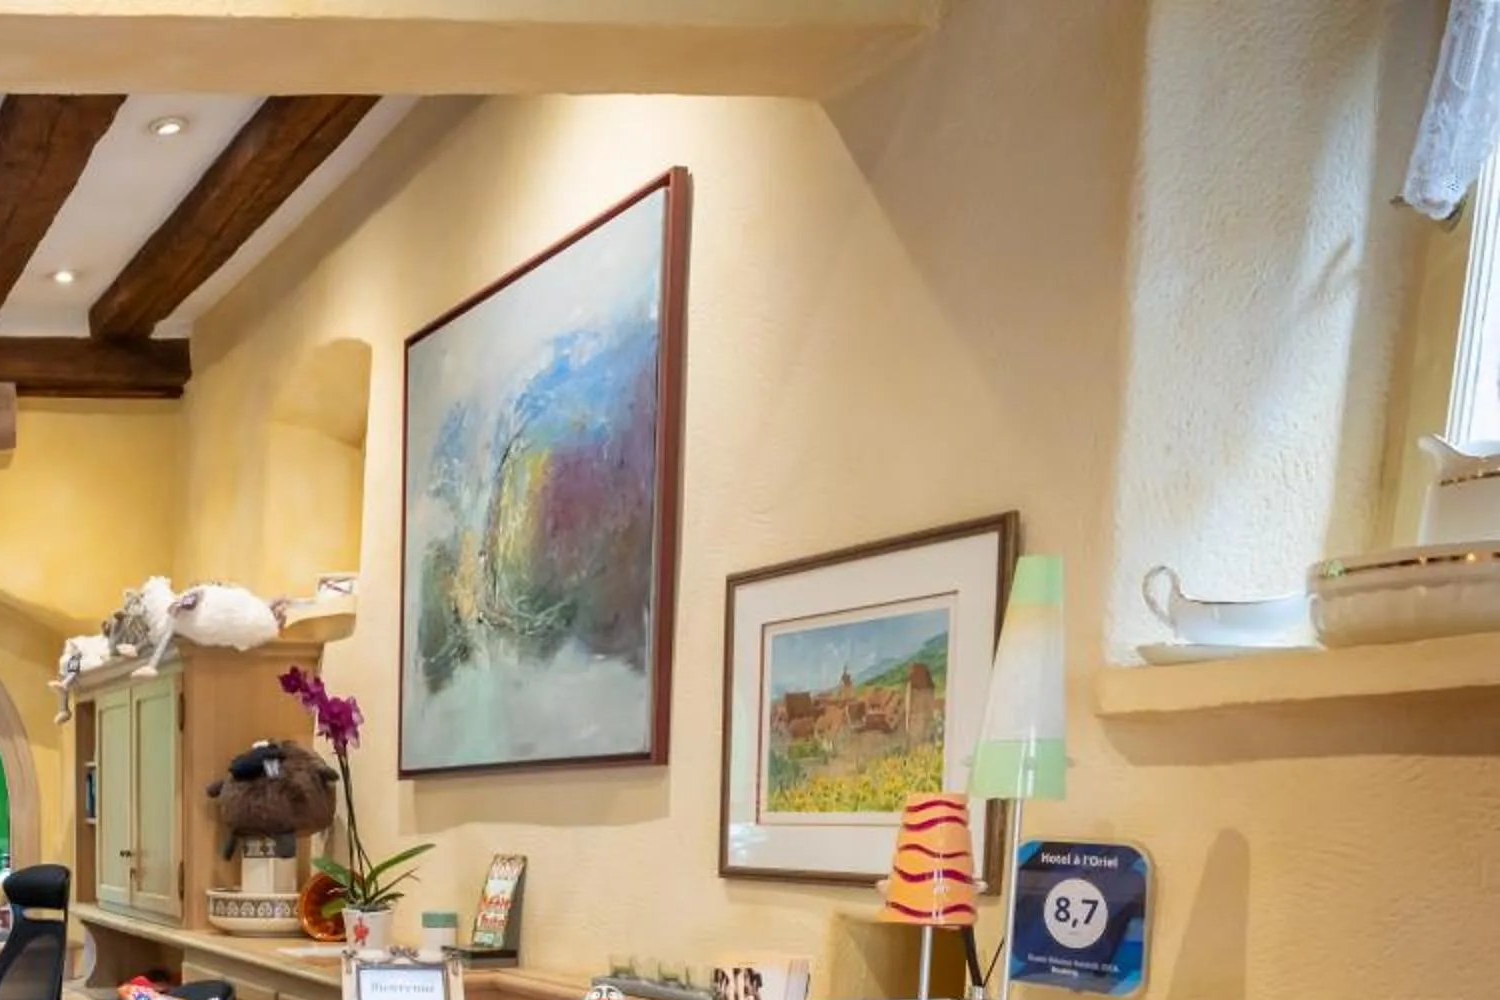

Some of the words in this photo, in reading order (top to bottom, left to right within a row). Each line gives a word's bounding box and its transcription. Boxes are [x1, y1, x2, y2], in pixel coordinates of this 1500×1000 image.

[1041, 852, 1071, 865] Hotel
[1073, 853, 1081, 865] à
[1083, 854, 1120, 868] l'Oriel
[1054, 896, 1099, 928] 8,7
